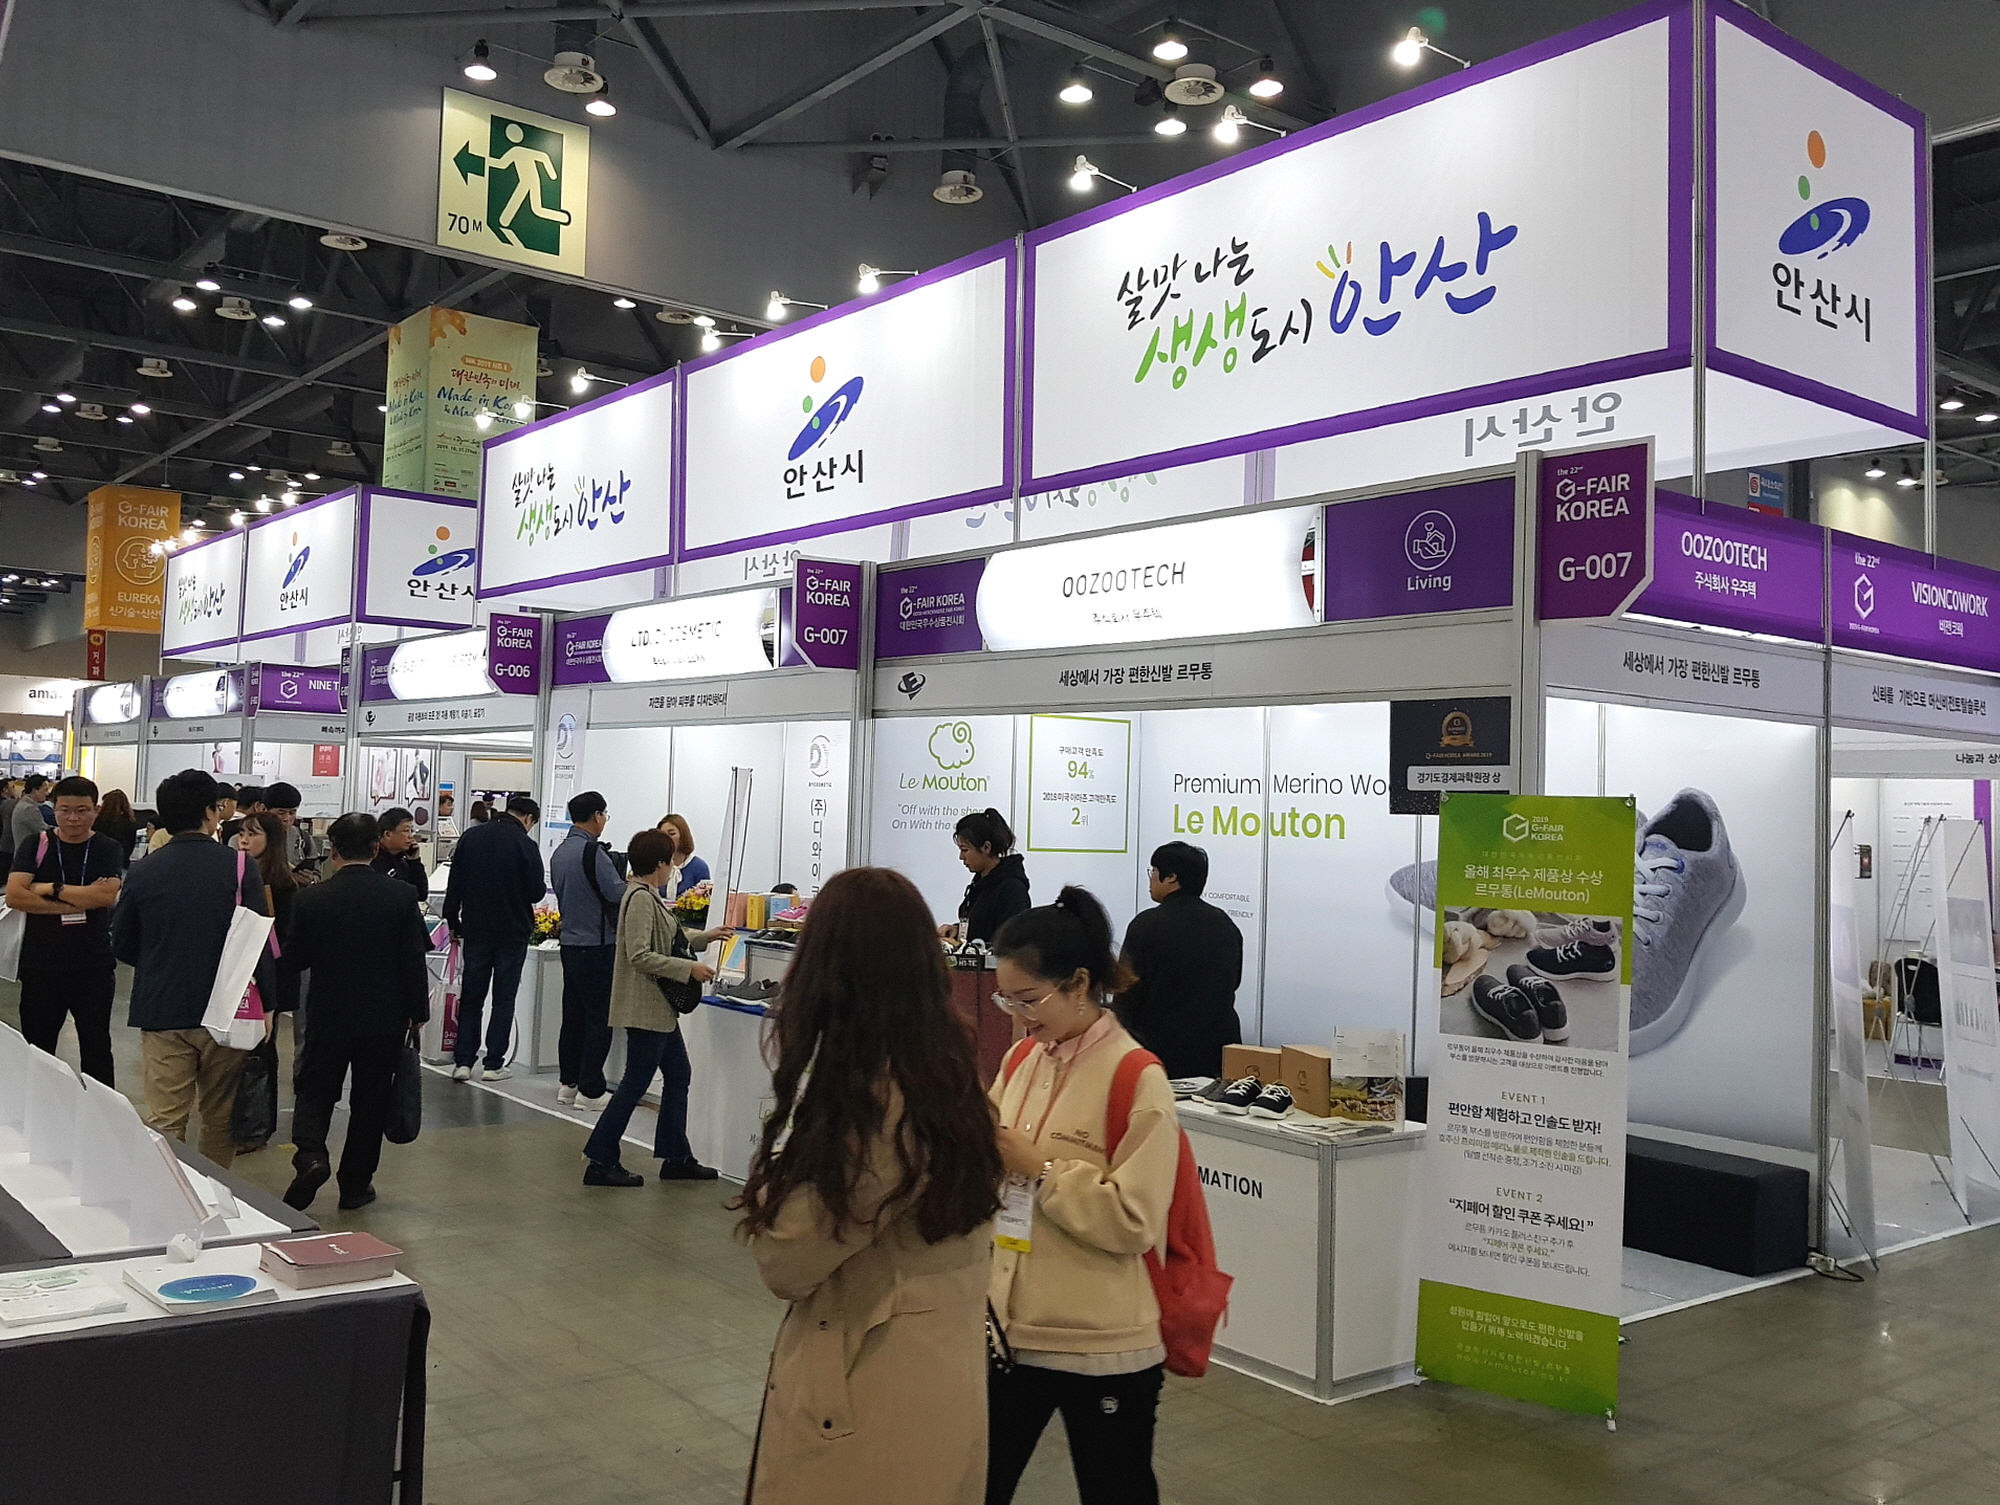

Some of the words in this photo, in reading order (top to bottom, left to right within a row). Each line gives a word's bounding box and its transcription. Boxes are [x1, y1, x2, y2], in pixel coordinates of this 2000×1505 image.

[1329, 211, 1518, 336] 안산
[1772, 262, 1871, 343] 안산시
[437, 386, 473, 402] Made
[451, 405, 476, 418] Mad
[783, 449, 865, 500] 안산시
[1557, 467, 1568, 476] the
[1570, 465, 1583, 475] 22nd
[1556, 473, 1631, 501] G-FAIR
[118, 500, 169, 518] G-FAIR
[577, 470, 631, 531] 안산
[1556, 496, 1630, 523] KOREA
[118, 515, 168, 532] KOREA
[1680, 531, 1768, 571] OOZOOTECH
[1854, 552, 1866, 567] the
[1558, 551, 1633, 582] G-007
[806, 575, 851, 593] G-FAIR
[1062, 561, 1186, 598] OOZOOTECH
[1407, 574, 1452, 592] Living
[1694, 571, 1730, 595] 주식회사
[1731, 577, 1757, 600] 우주텍
[117, 592, 161, 605] EUREKA
[279, 587, 309, 612] 안산시
[806, 591, 850, 608] KOREA
[936, 593, 965, 605] KOREA
[1911, 580, 1989, 618] VISIONCOWORK
[497, 637, 533, 650] KOREA
[804, 626, 848, 645] G-007
[494, 663, 531, 678] G-006
[1058, 668, 1099, 687] 세상에서
[1103, 667, 1125, 685] 가장
[1128, 664, 1173, 683] 편한신발
[1176, 662, 1213, 681] 르무통
[1622, 651, 1665, 676] 세상에서
[1668, 656, 1688, 679] 가장
[1691, 660, 1729, 684] 편한신발
[1732, 667, 1760, 689] 르무통
[308, 679, 331, 691] NINE
[1899, 688, 1927, 708] 기반으로
[1955, 753, 1984, 765] 나눔과
[899, 772, 920, 790] Le
[1174, 772, 1261, 795] Premium
[1273, 772, 1343, 795] Merino
[1350, 773, 1390, 796] Wo
[1492, 771, 1501, 784] 상
[919, 804, 940, 816] with
[942, 805, 959, 817] the
[891, 819, 907, 830] On
[909, 818, 933, 830] With
[934, 819, 951, 830] the
[1173, 803, 1204, 835] Le
[1212, 805, 1346, 840] Mouton
[1531, 823, 1565, 833] G-FAIR
[1530, 832, 1564, 842] KOREA
[1464, 863, 1490, 880] 올해
[1492, 864, 1530, 881] 최우수
[1533, 867, 1573, 884] 제품상
[1576, 870, 1604, 886] 수상
[1475, 883, 1591, 904] 르무통(LeMouton)
[1501, 1091, 1537, 1103] EVENT
[1541, 1096, 1546, 1105] 1
[1448, 1102, 1483, 1118] 편안함
[1484, 1106, 1533, 1124] 체험하고
[1534, 1113, 1570, 1130] 인솔도
[1572, 1118, 1602, 1135] 받자!
[1496, 1186, 1532, 1201] EVENT
[1536, 1193, 1543, 1203] 2
[1492, 1204, 1516, 1221] 할인
[1517, 1208, 1542, 1226] 쿠폰
